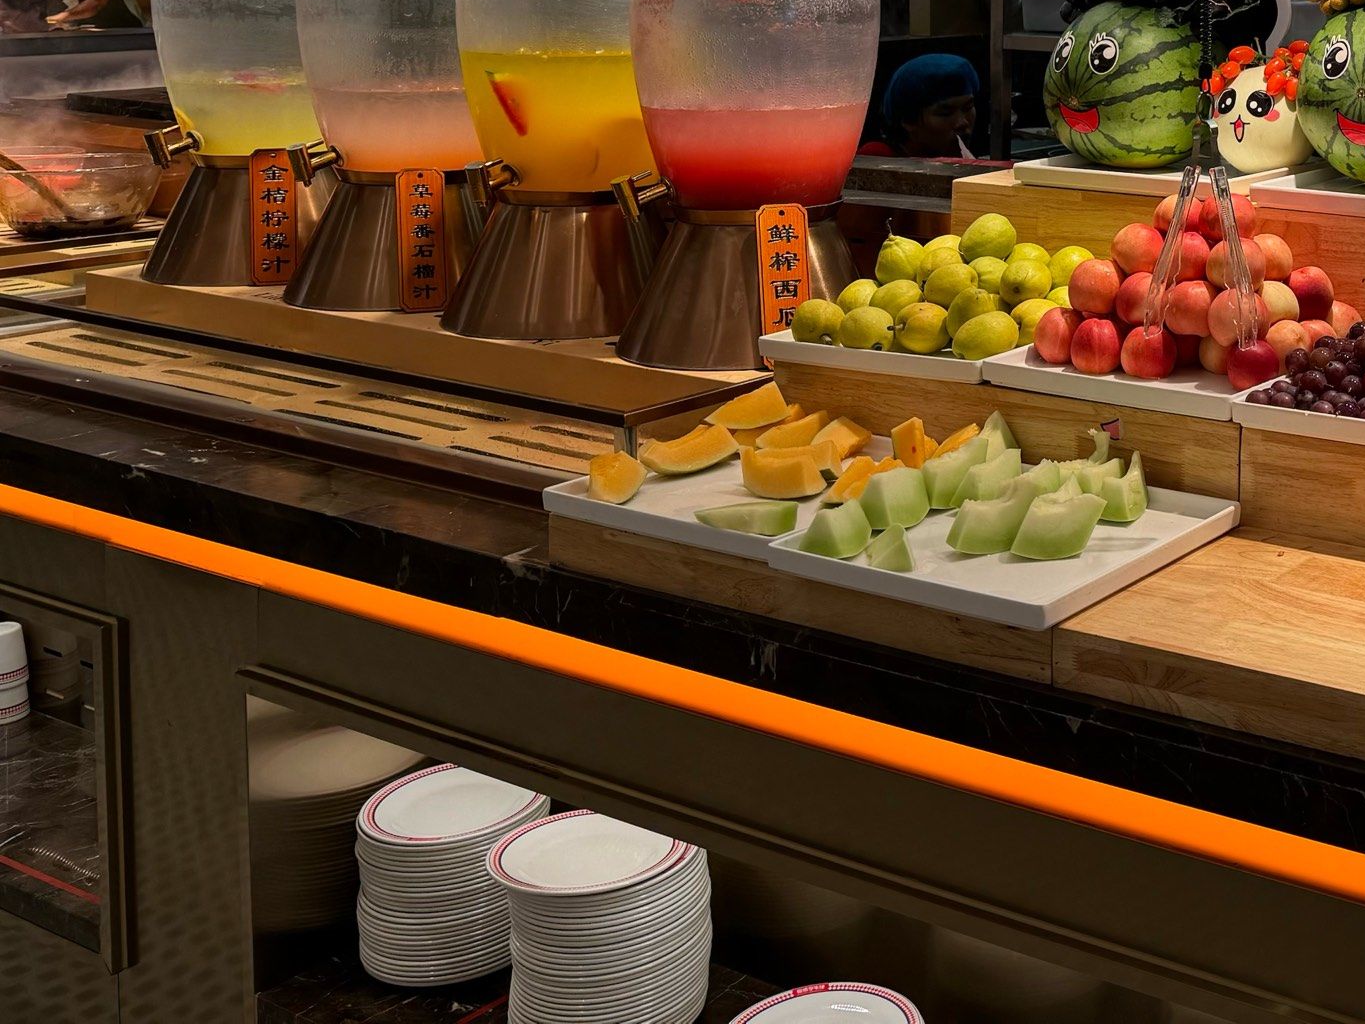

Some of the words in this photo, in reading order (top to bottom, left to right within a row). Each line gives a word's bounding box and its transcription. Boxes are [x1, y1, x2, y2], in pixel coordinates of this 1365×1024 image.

[259, 164, 290, 274] 金桔柠檬汁
[409, 183, 437, 301] 草莓番石榴汁
[766, 223, 802, 329] 鲜榨西瓜
